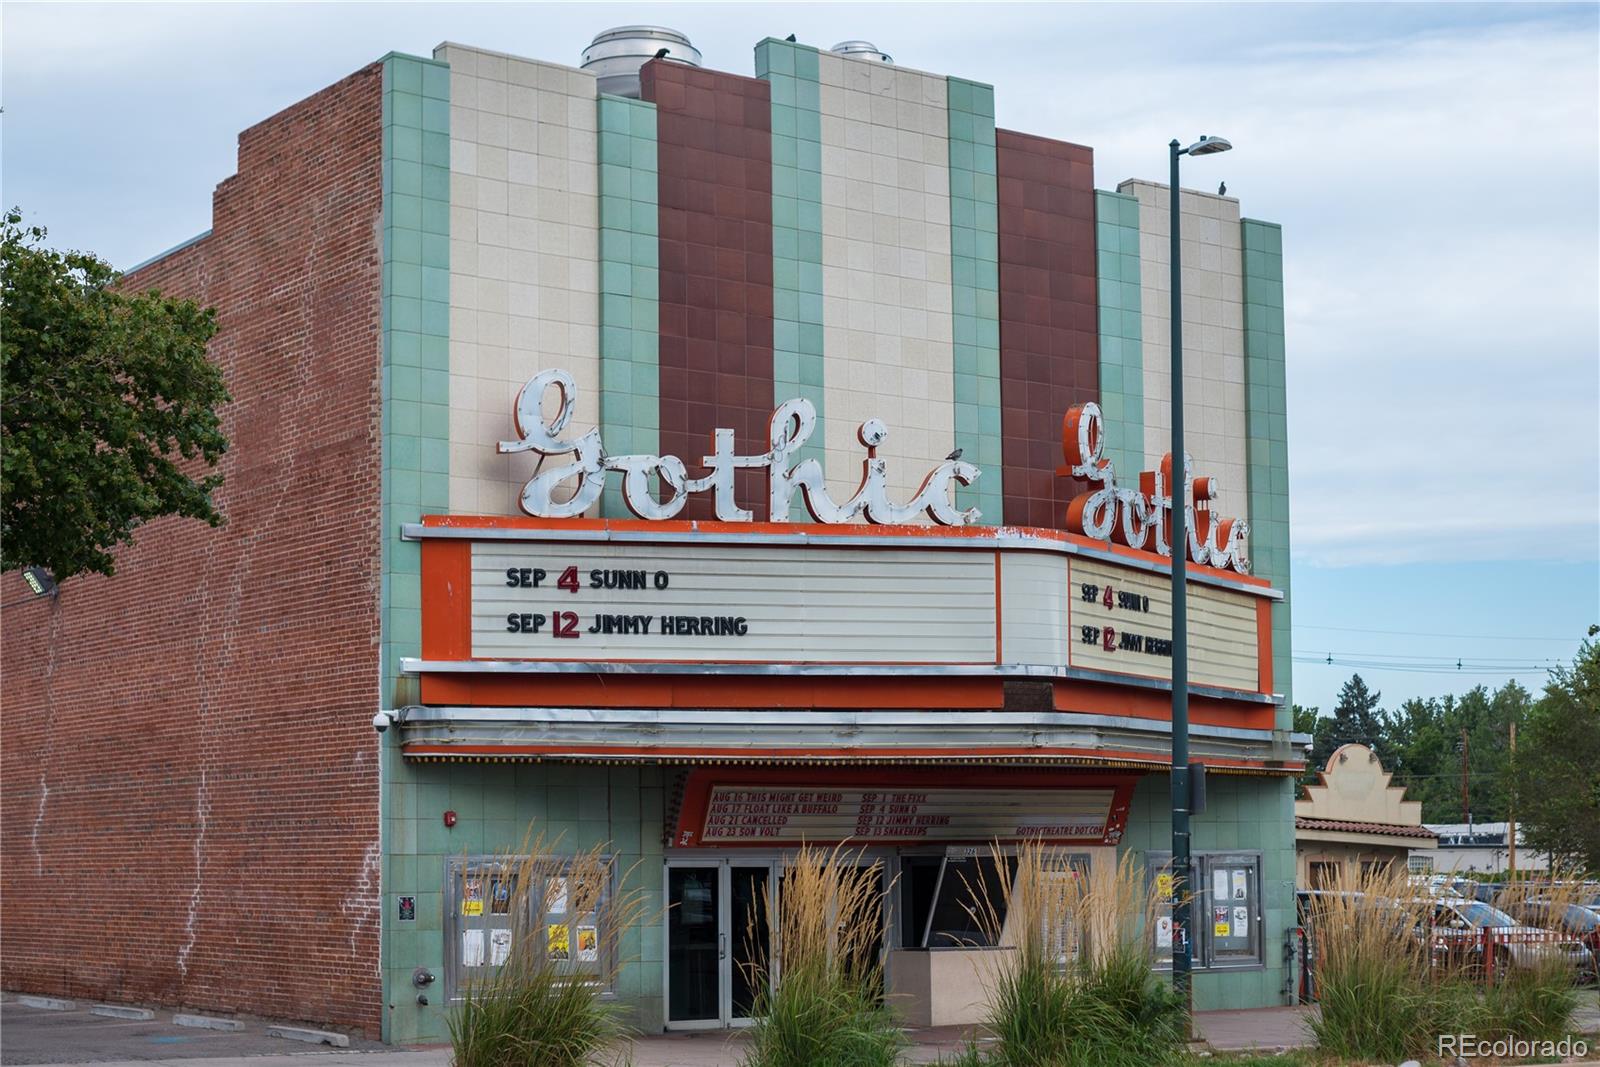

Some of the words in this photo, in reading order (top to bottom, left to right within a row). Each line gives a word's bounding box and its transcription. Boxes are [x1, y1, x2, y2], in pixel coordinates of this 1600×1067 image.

[497, 368, 982, 526] Gothic
[506, 568, 546, 588] SEP
[556, 565, 580, 593] 4
[589, 569, 647, 589] SUNN
[1081, 583, 1099, 603] SEP
[1103, 585, 1114, 611] 4
[506, 613, 546, 633] SEP
[552, 611, 580, 638] 12
[588, 613, 652, 635] JIMMY
[661, 615, 748, 636] HERRING
[1081, 625, 1100, 645] SEP
[1103, 626, 1116, 652] 12
[713, 793, 730, 802] AUG
[746, 793, 767, 802] THIS
[768, 792, 795, 803] MIGHT
[798, 793, 813, 803] GET
[815, 793, 843, 803] WEIRD
[861, 794, 877, 803] SEP
[711, 804, 728, 814] AUG
[732, 804, 741, 814] 17
[743, 804, 770, 814] FLOAT
[771, 804, 793, 814] LIKE
[792, 804, 800, 814] A
[801, 804, 838, 815] BUFFALO
[859, 804, 875, 814] SEP
[879, 804, 885, 814] 4
[708, 816, 726, 825] AUG
[728, 816, 738, 825] 21
[741, 816, 788, 825] CANCELLED
[857, 815, 872, 825] SEP
[875, 815, 884, 825] 12
[886, 815, 913, 825] JIMMY
[915, 815, 950, 825] HERRING
[706, 827, 723, 837] AUG
[726, 827, 736, 836] 23
[739, 827, 755, 837] SON
[760, 827, 781, 837] VOLT
[855, 826, 870, 837] SEP
[873, 827, 882, 837] 13
